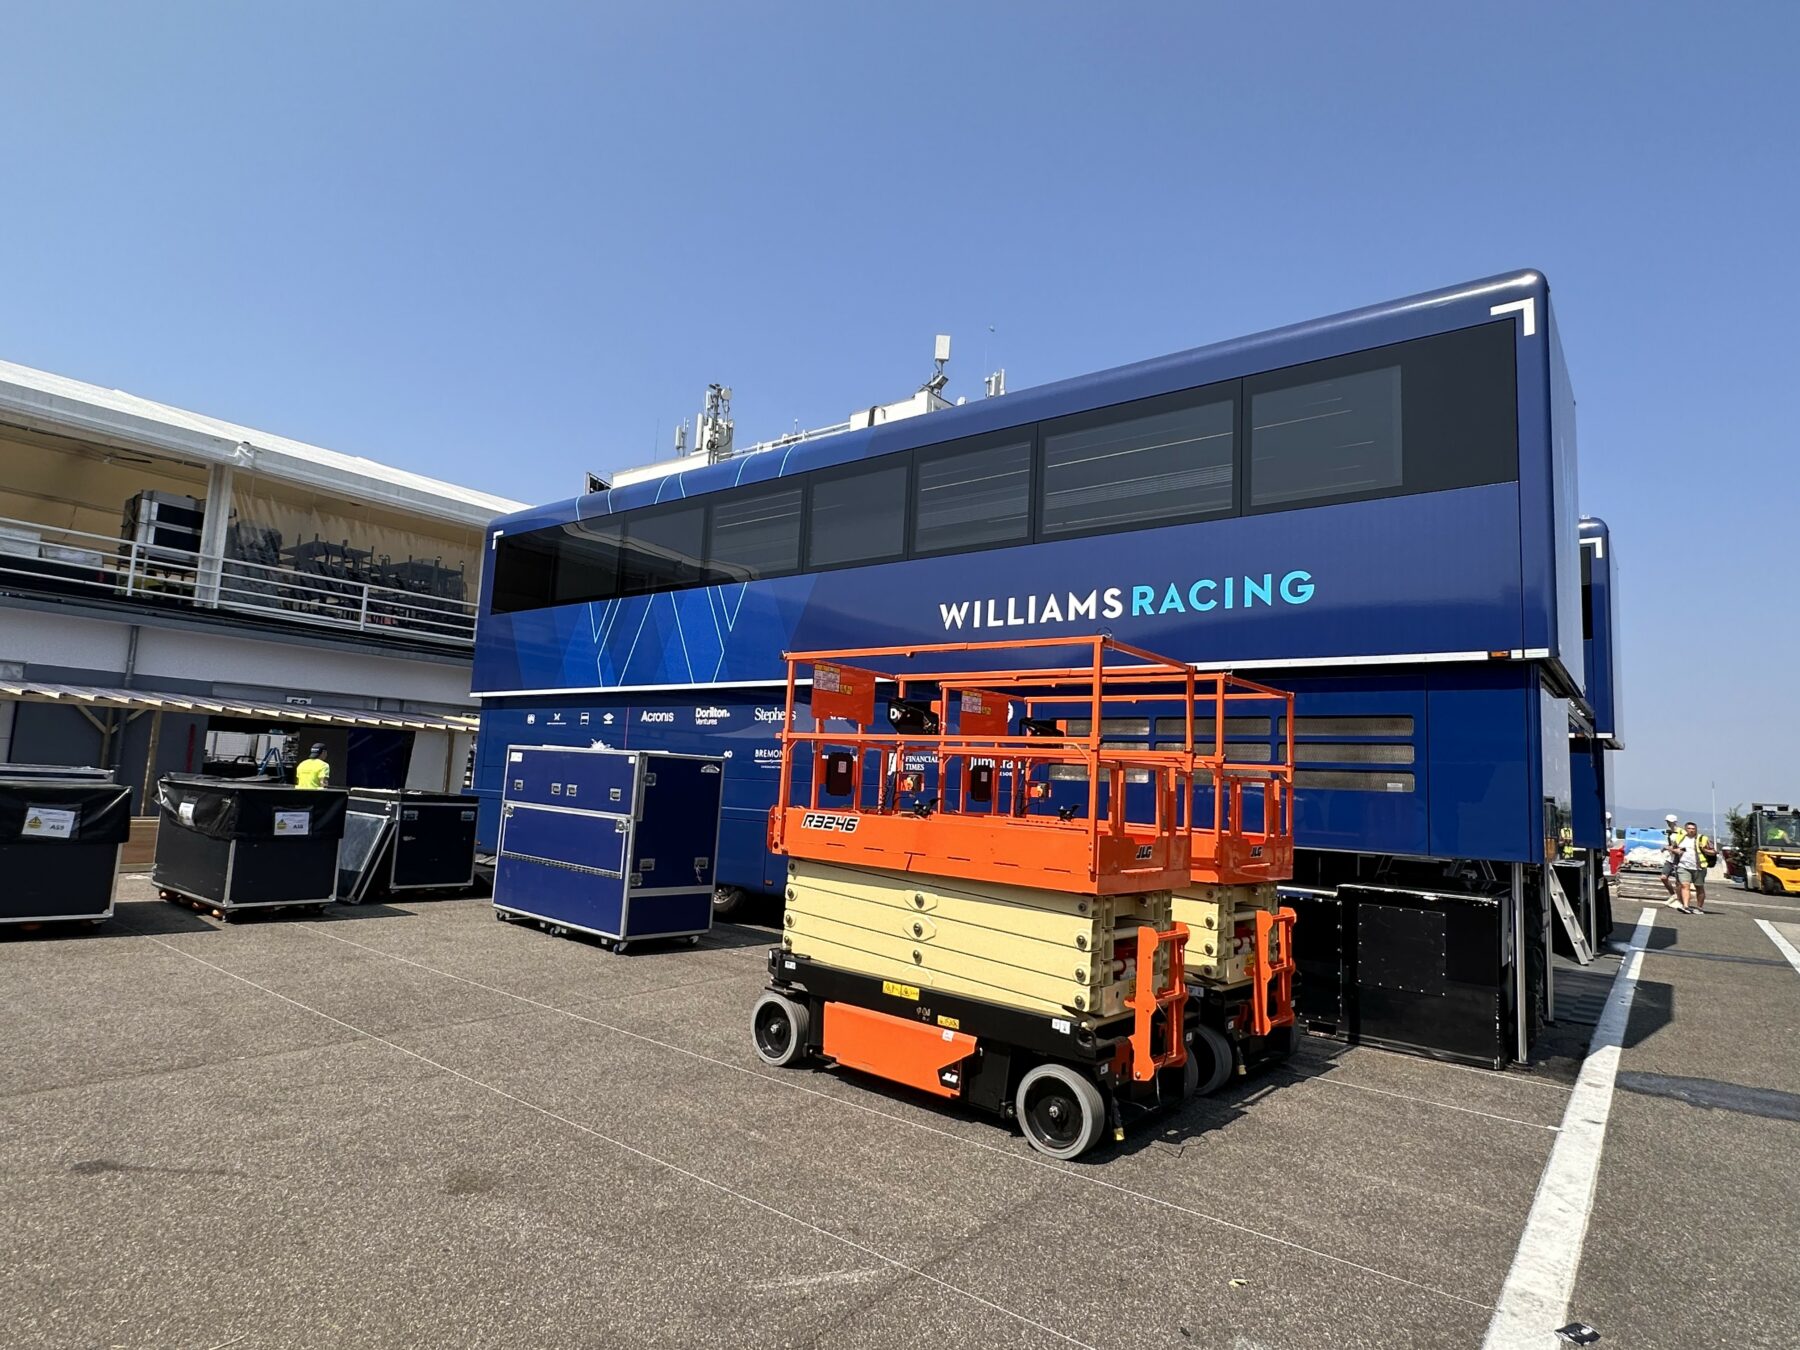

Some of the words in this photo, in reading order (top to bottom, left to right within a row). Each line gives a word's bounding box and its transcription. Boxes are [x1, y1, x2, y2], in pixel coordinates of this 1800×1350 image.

[939, 587, 1123, 630] WILLIAMS
[1132, 570, 1315, 617] RACING
[640, 710, 675, 723] Acronis
[695, 707, 728, 718] Dorilton
[754, 707, 797, 724] Stephes
[905, 755, 940, 763] FINANCIAL
[905, 763, 925, 771] TIMES
[802, 814, 859, 832] R3246
[1136, 845, 1153, 859] JLG
[1250, 846, 1264, 858] JLG
